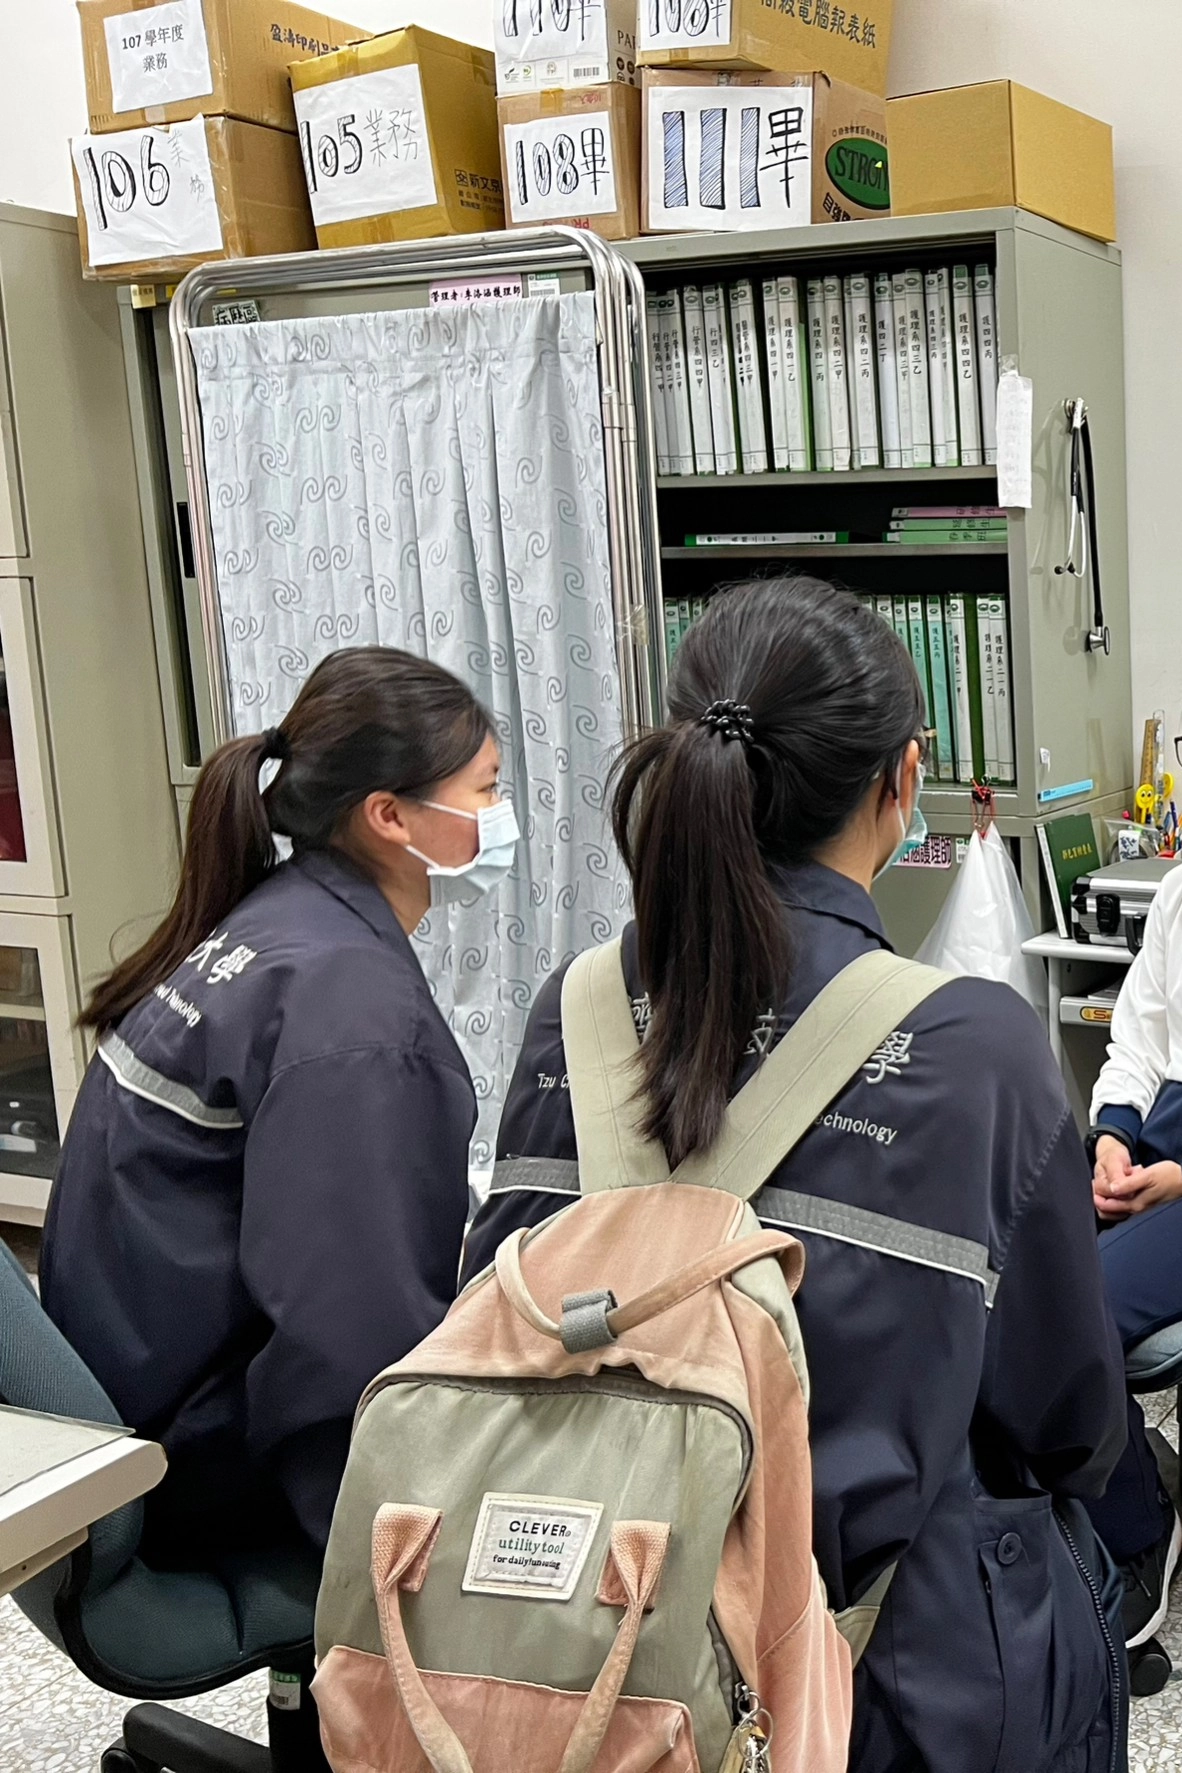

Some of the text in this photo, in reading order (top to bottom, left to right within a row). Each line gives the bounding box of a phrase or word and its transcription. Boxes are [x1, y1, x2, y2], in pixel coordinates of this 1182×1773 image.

[122, 23, 184, 50] 107 學年度
[143, 52, 168, 72] 業務
[82, 134, 171, 231] 106
[537, 1073, 557, 1089] Tzu
[509, 1520, 567, 1537] CLEVER
[498, 1537, 565, 1555] utility tool
[492, 1554, 508, 1563] for
[508, 1555, 529, 1567] daily
